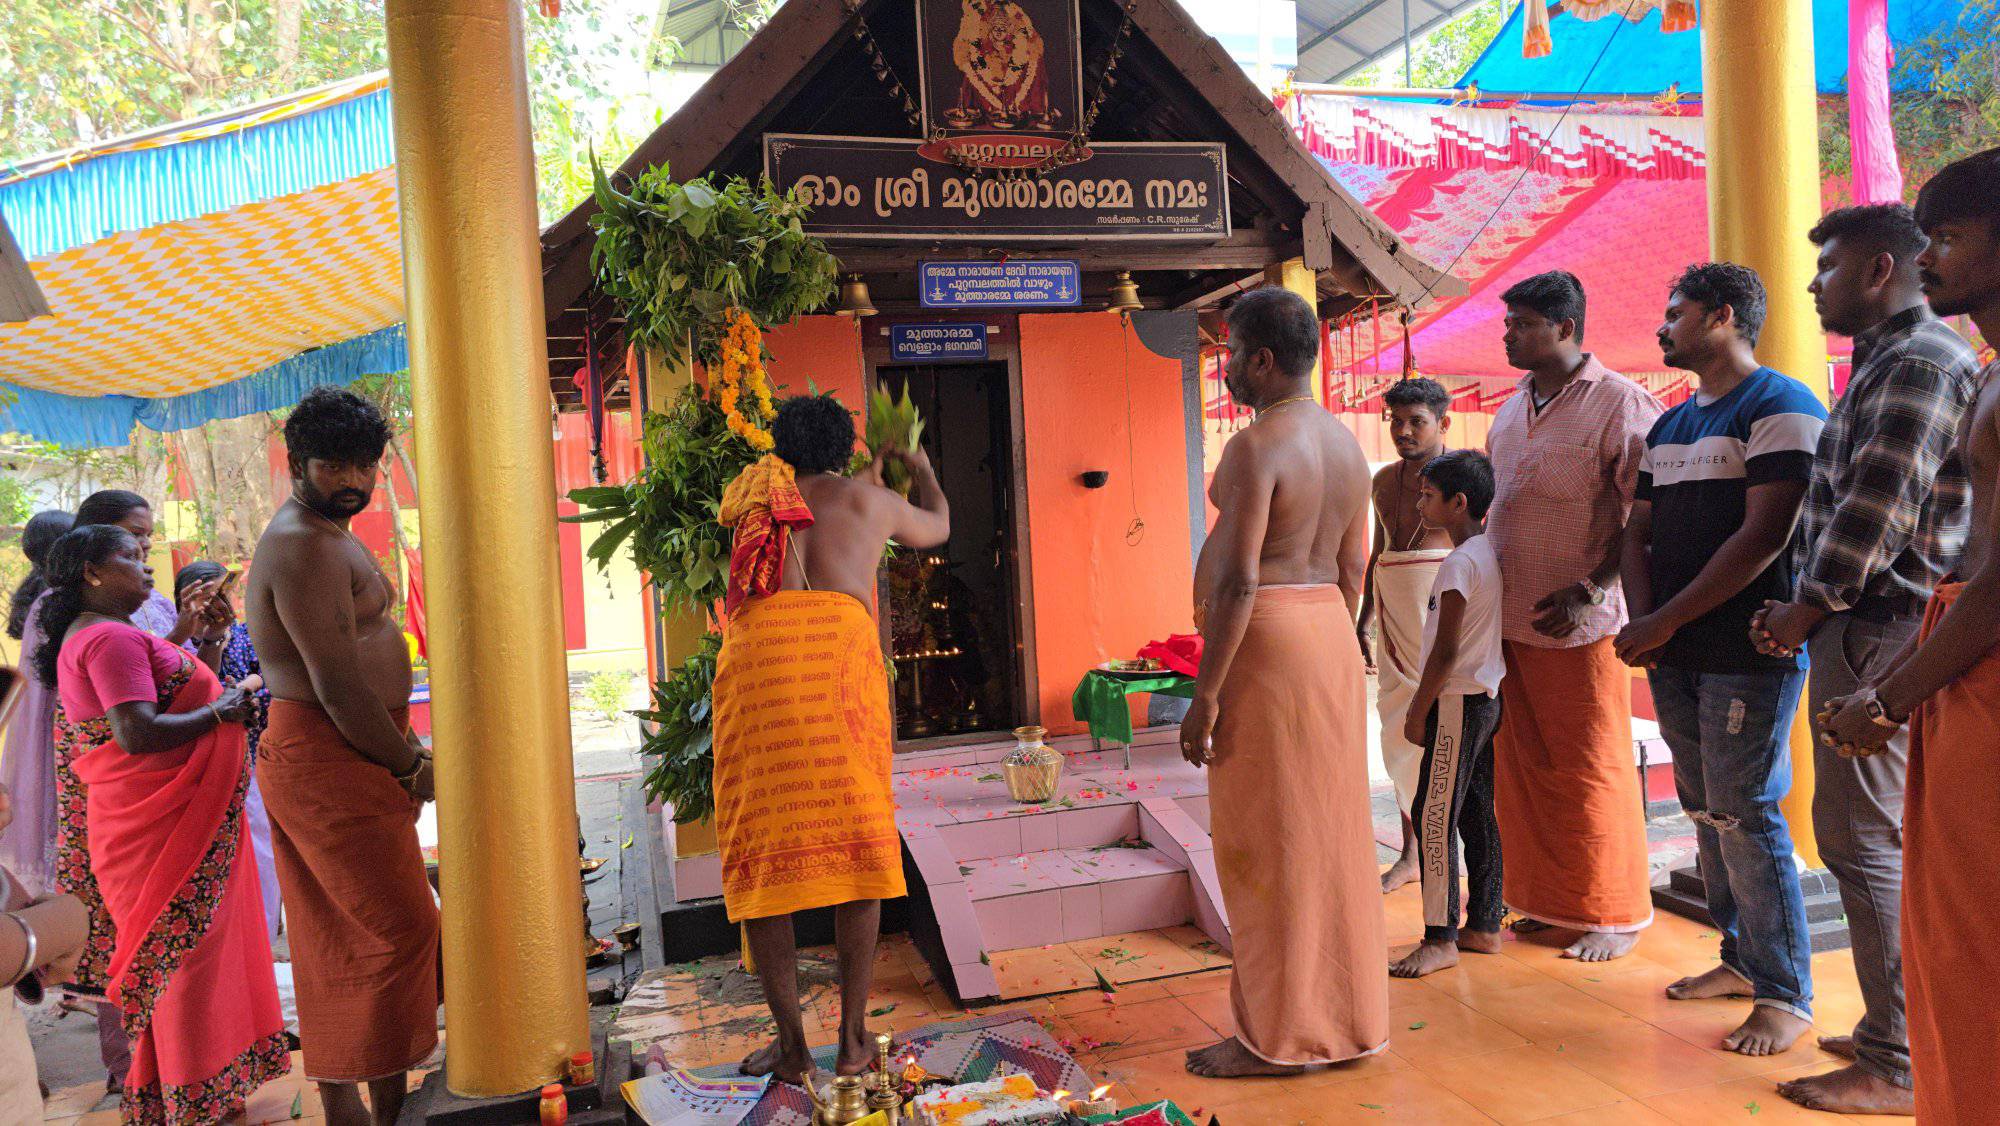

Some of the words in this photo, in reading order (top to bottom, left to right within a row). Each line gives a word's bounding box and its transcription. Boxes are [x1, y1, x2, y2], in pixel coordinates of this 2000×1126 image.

[795, 174, 861, 207] ഓം
[874, 167, 930, 217] ശ്രീ
[942, 178, 1134, 217] മുത്താരമ്മേ
[1145, 179, 1208, 208] നമഃ
[927, 266, 956, 277] അമ്മേ
[958, 267, 1003, 277] നാരായണ
[1005, 264, 1026, 277] ദേവി
[1028, 266, 1072, 276] നാരായണ
[1023, 279, 1053, 290] വാഴും
[954, 290, 1011, 303] മുത്താരമ്മേ
[1013, 290, 1048, 300] ശരണം
[906, 328, 974, 341] മുത്താരമ്മ
[944, 338, 982, 352] ഭഗവതി
[1686, 455, 1728, 466] ILFIGER
[1431, 725, 1454, 800] STAR
[1426, 802, 1446, 877] WARS
